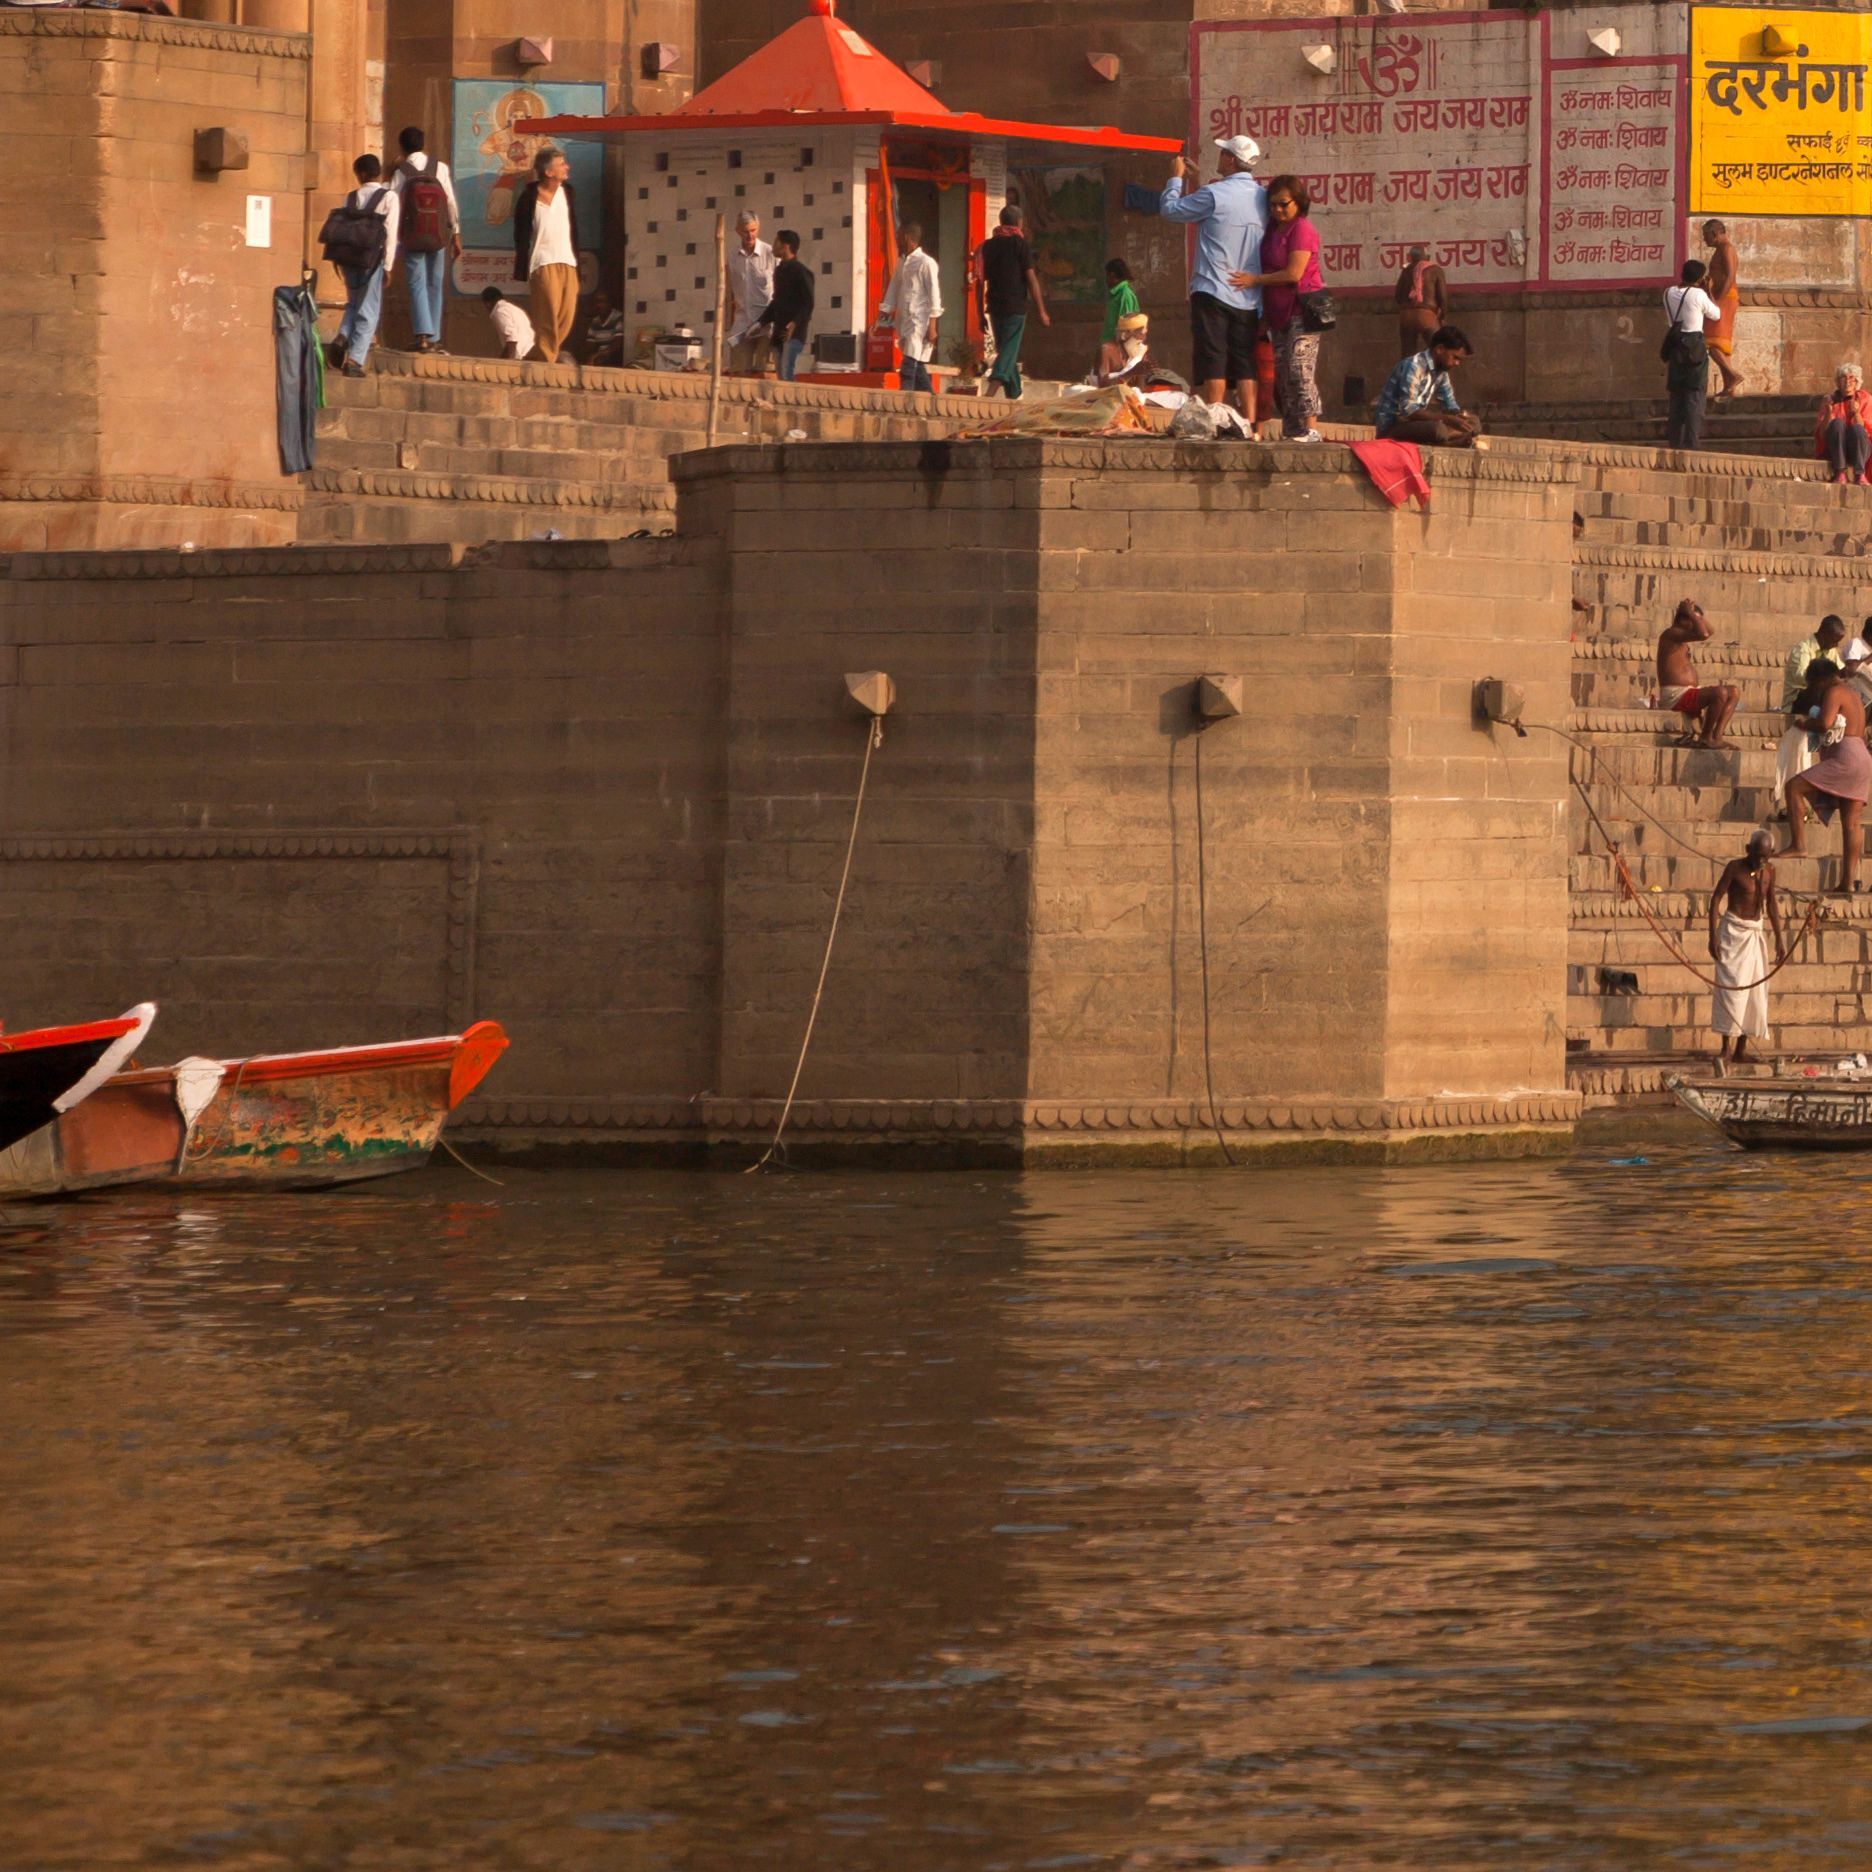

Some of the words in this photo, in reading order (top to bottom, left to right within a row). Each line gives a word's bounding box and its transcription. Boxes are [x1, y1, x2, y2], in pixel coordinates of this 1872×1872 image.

[1704, 42, 1868, 116] दरभंगा
[1616, 85, 1672, 110] शिवाय
[1210, 95, 1243, 140] श्री
[1246, 105, 1291, 139] राम
[1293, 102, 1339, 137] जय
[1340, 102, 1384, 135] राम
[1393, 100, 1440, 133] जय
[1441, 97, 1487, 130] जय
[1489, 96, 1532, 129] राम
[1616, 122, 1668, 150] शिवाय
[1786, 130, 1832, 152] सफाई
[1333, 172, 1376, 205] राम
[1383, 170, 1432, 203] जय
[1433, 167, 1486, 201] जय
[1487, 164, 1532, 199] राम
[1615, 163, 1669, 190] शिवाय
[1712, 162, 1754, 189] सुलभ
[1612, 205, 1663, 229] शिवाय
[1323, 244, 1362, 272] राम
[1435, 239, 1488, 268] जय
[1609, 238, 1665, 263] शिवाय
